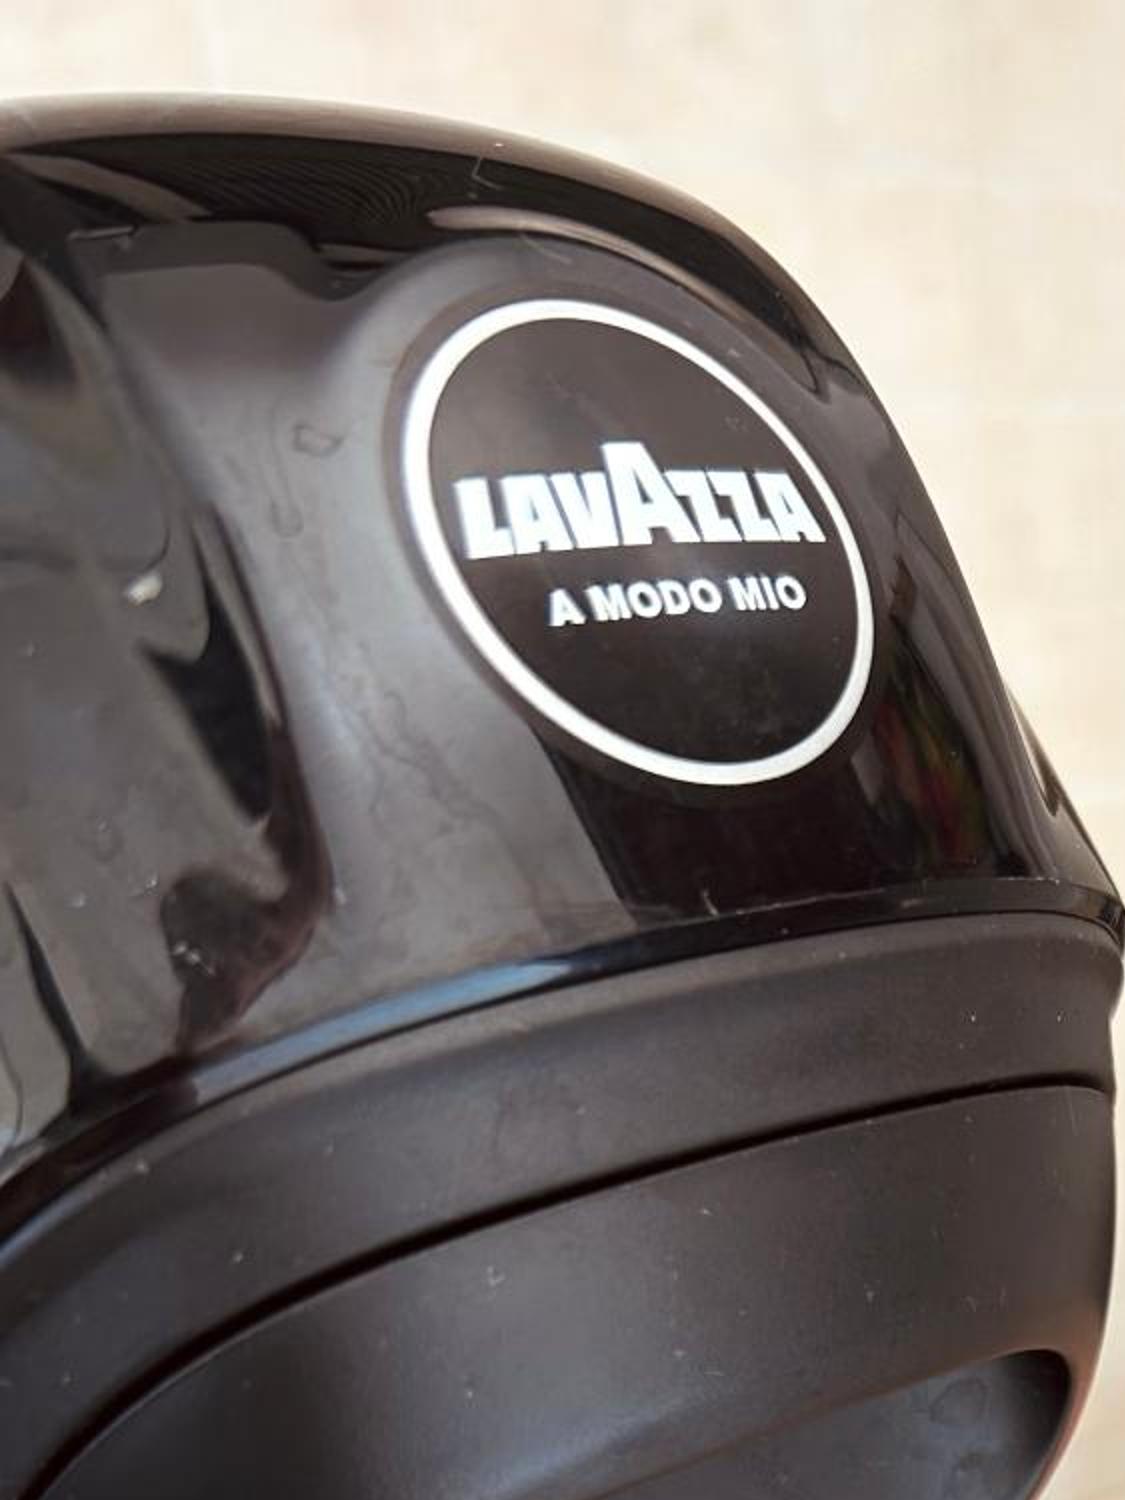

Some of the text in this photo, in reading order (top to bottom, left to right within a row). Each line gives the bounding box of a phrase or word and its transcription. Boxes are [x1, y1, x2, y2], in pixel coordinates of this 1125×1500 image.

[453, 441, 827, 559] LAVAZZA
[547, 575, 806, 626] A MODO MIO
